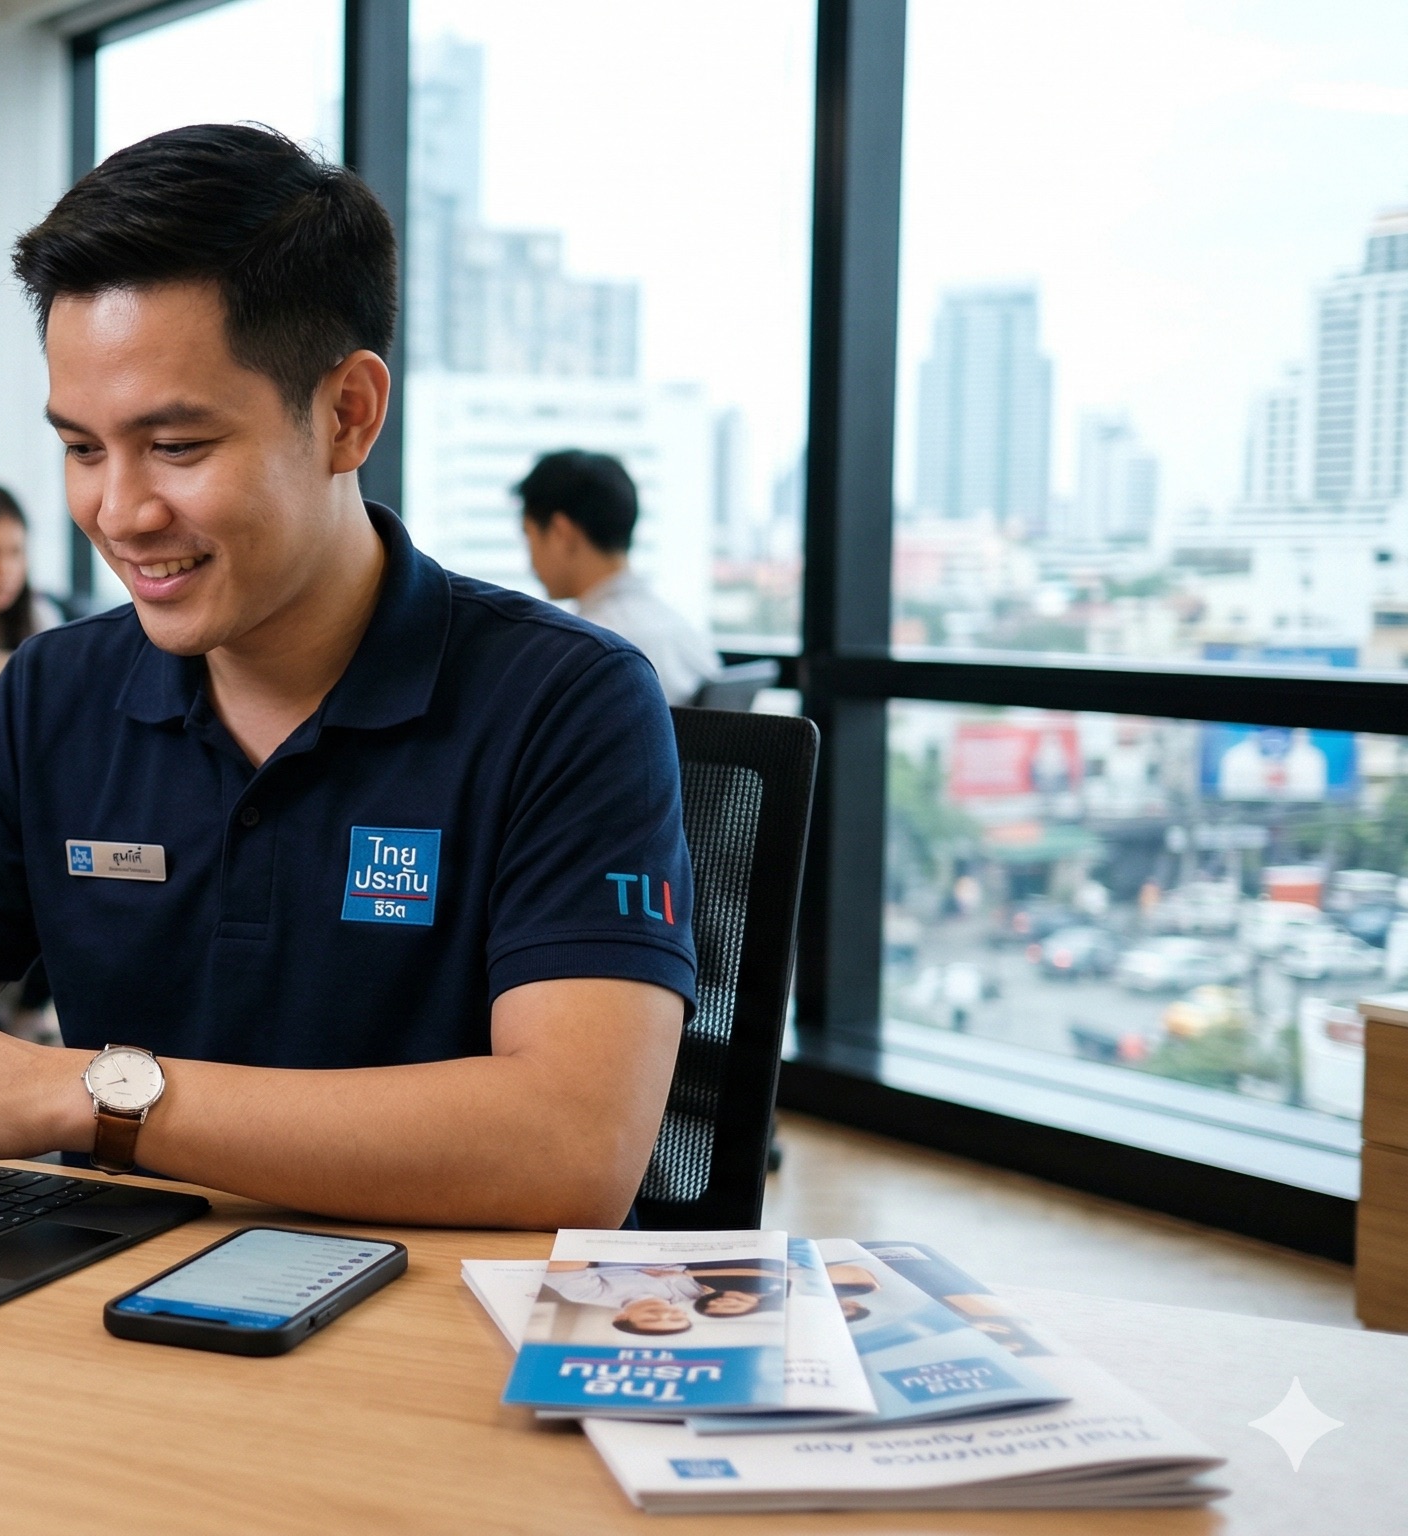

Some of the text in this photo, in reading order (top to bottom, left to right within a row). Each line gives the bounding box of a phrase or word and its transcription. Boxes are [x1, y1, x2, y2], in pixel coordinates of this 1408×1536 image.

[368, 836, 416, 866] ไทย
[355, 864, 428, 893] ประกัน
[374, 900, 406, 918] ชีวิต
[605, 872, 675, 925] TLI
